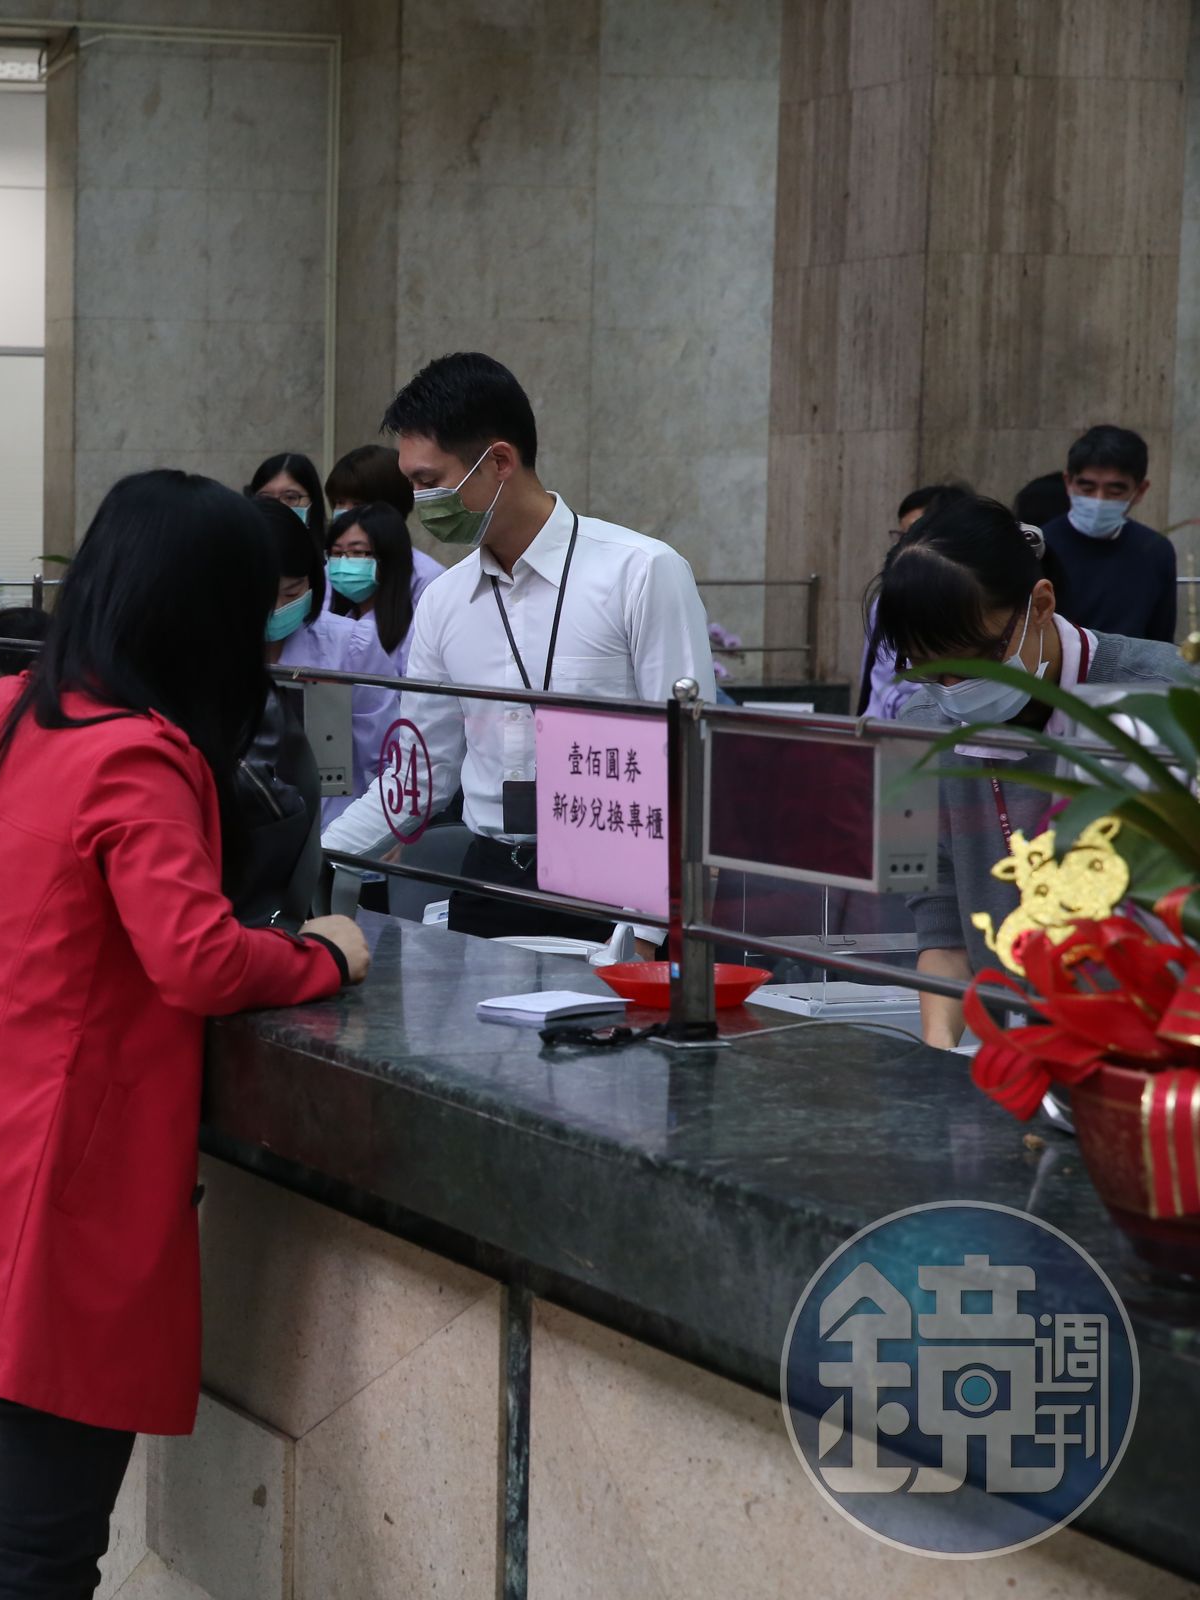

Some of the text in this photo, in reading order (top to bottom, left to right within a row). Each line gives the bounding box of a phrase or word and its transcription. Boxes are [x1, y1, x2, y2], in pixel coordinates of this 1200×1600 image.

[387, 740, 421, 817] 34
[568, 741, 641, 783] 壹佰圓券
[552, 791, 664, 840] 新鈔兌換專櫃
